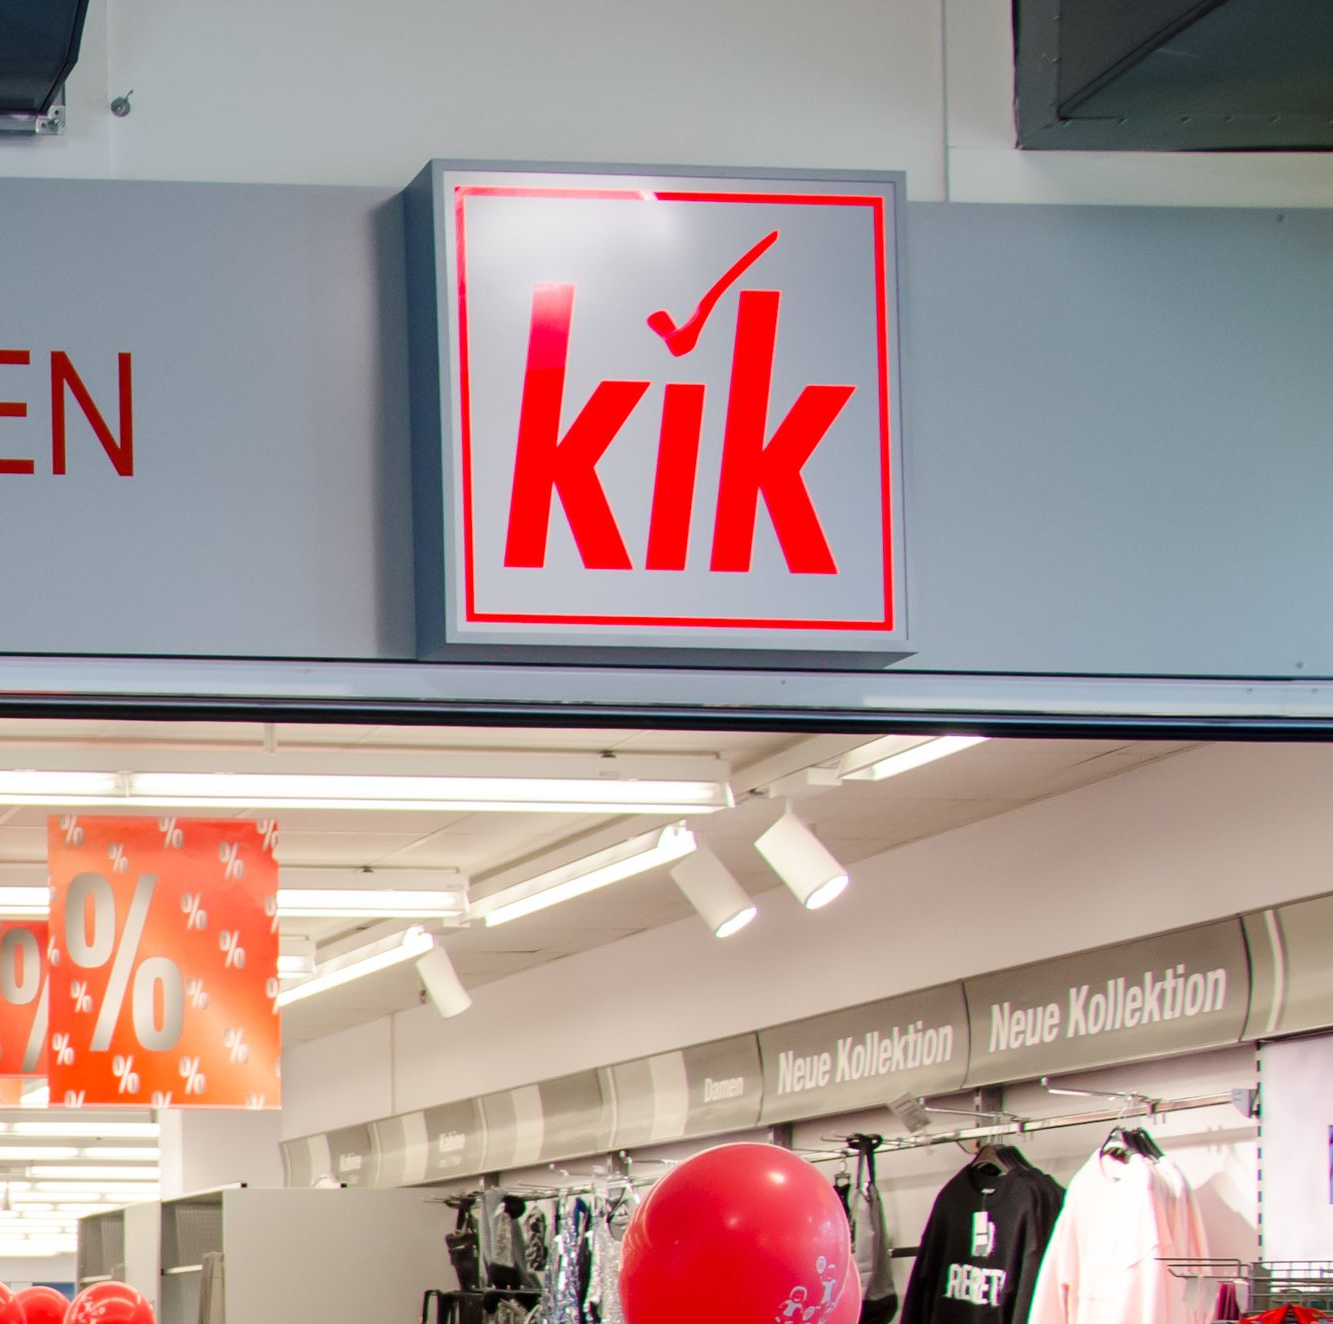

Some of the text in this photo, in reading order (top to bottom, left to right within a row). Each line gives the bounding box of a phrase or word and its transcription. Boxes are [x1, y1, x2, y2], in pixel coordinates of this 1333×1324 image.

[503, 229, 857, 575] kik
[988, 963, 1227, 1053] Neue Kollektion
[703, 1075, 744, 1103] Damen
[778, 1020, 953, 1096] Neue Kollektion
